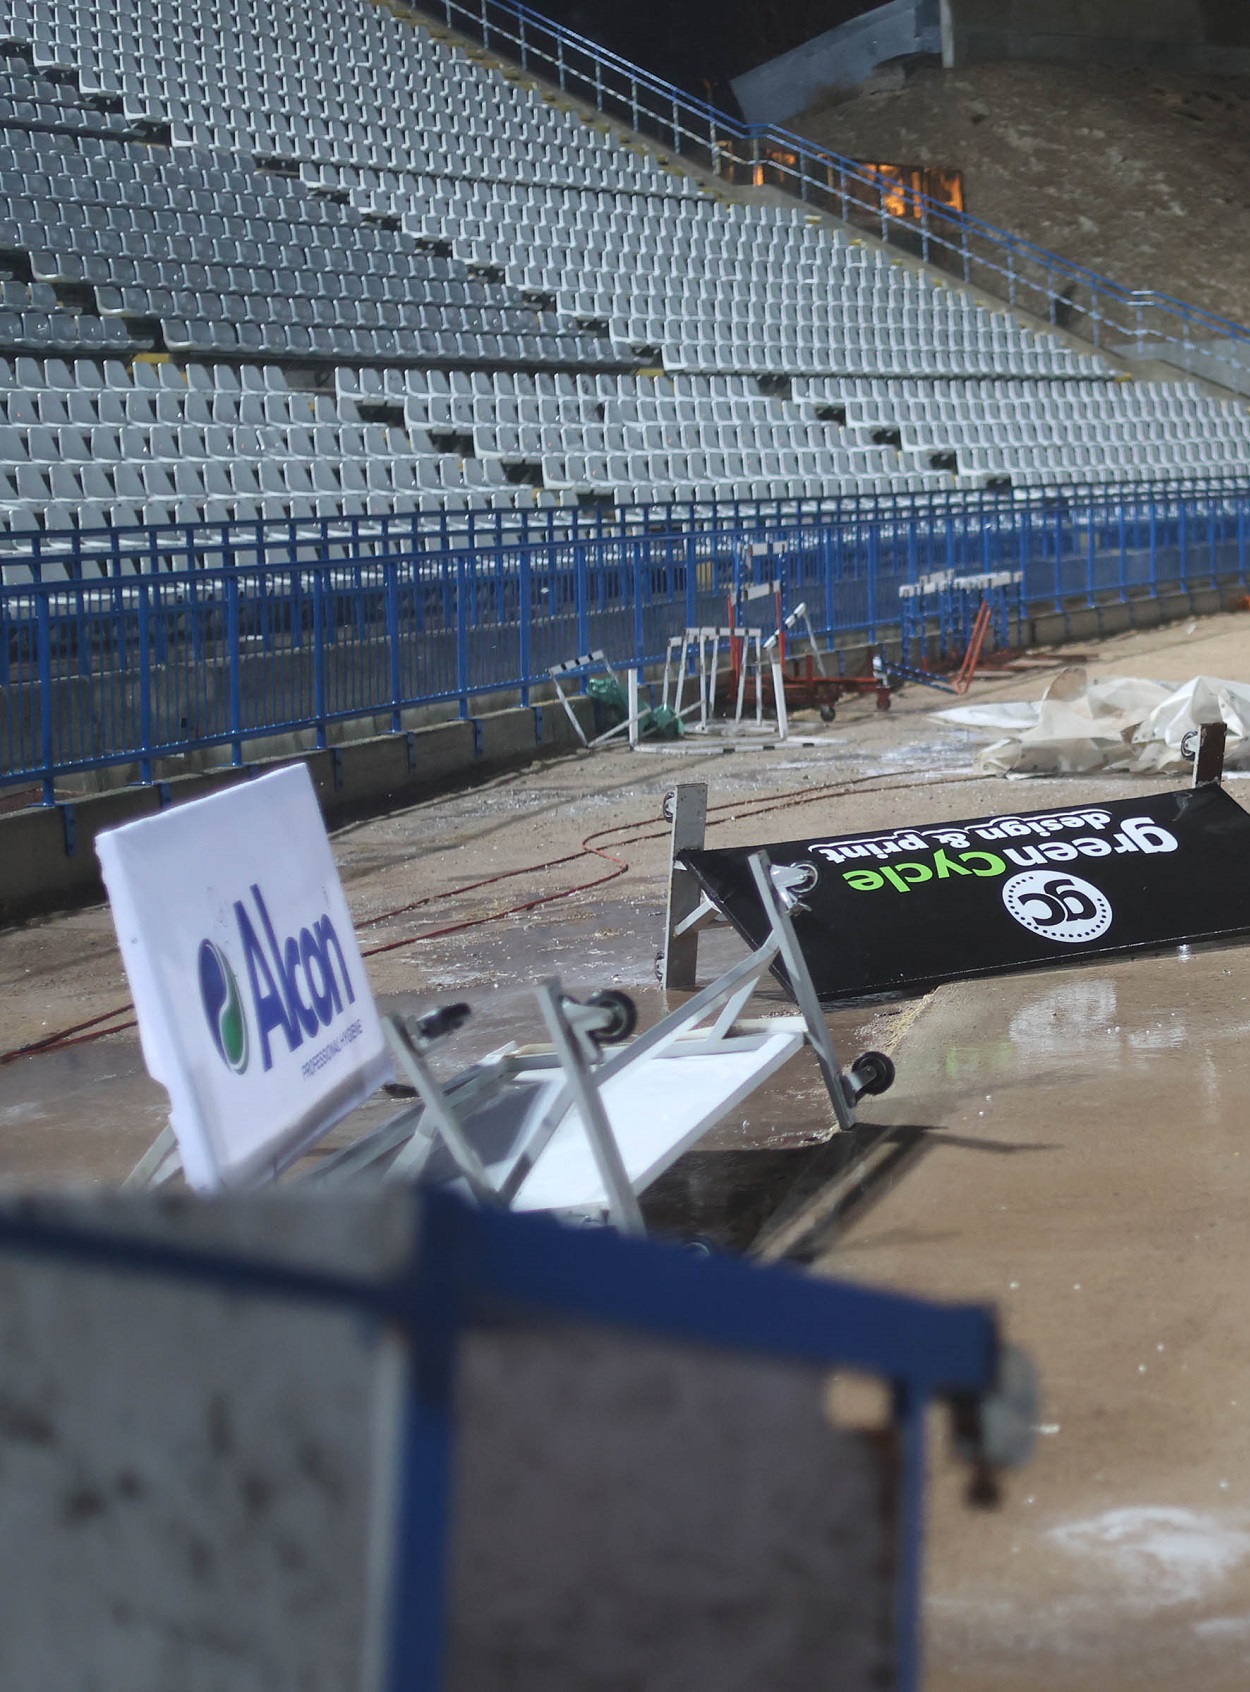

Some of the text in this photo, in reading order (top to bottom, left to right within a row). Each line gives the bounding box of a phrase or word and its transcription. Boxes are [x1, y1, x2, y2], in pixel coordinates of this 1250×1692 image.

[818, 811, 1112, 864] design & print
[1003, 816, 1179, 867] green
[233, 883, 356, 1073] Alcon
